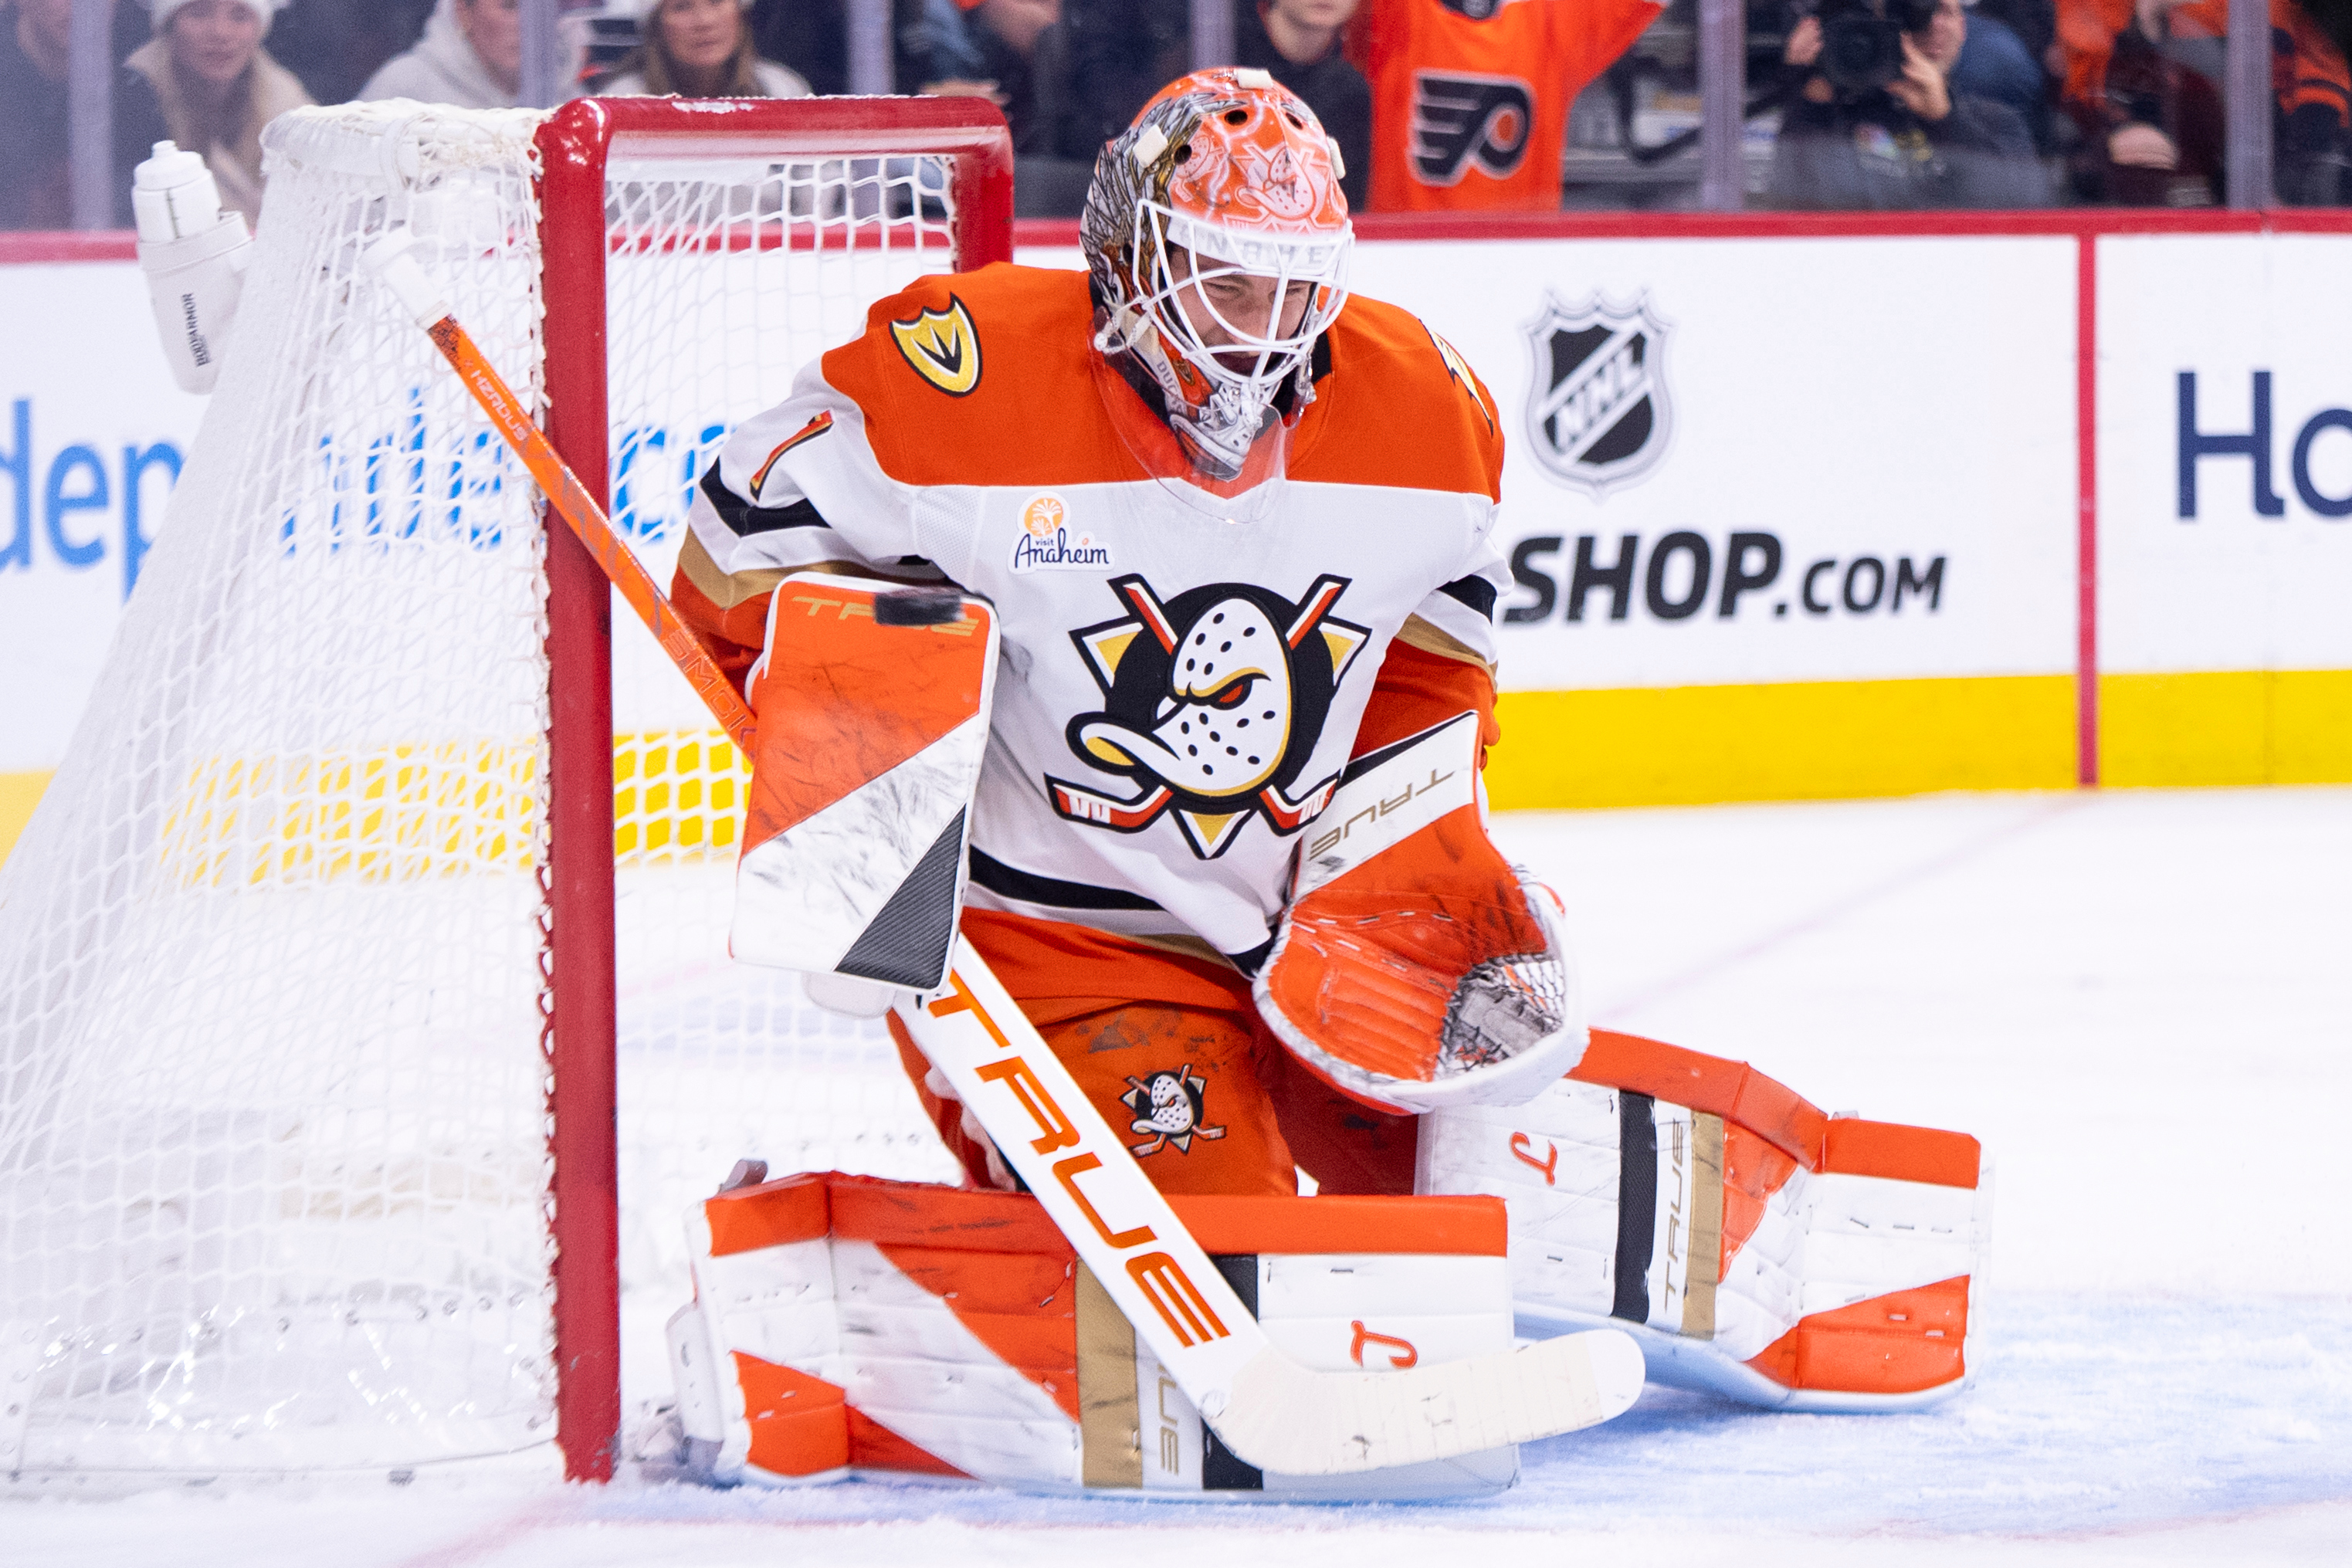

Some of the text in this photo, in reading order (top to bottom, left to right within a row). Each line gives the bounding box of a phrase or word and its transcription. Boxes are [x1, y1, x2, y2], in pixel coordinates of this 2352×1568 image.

[1553, 343, 1643, 452] NHL
[2176, 370, 2352, 520] Ho
[1015, 527, 1110, 569] Anaheim
[791, 595, 980, 637] TRE
[1308, 767, 1456, 862] TRUE
[927, 968, 1231, 1349] TRUE
[1664, 1117, 1683, 1313] TRUE
